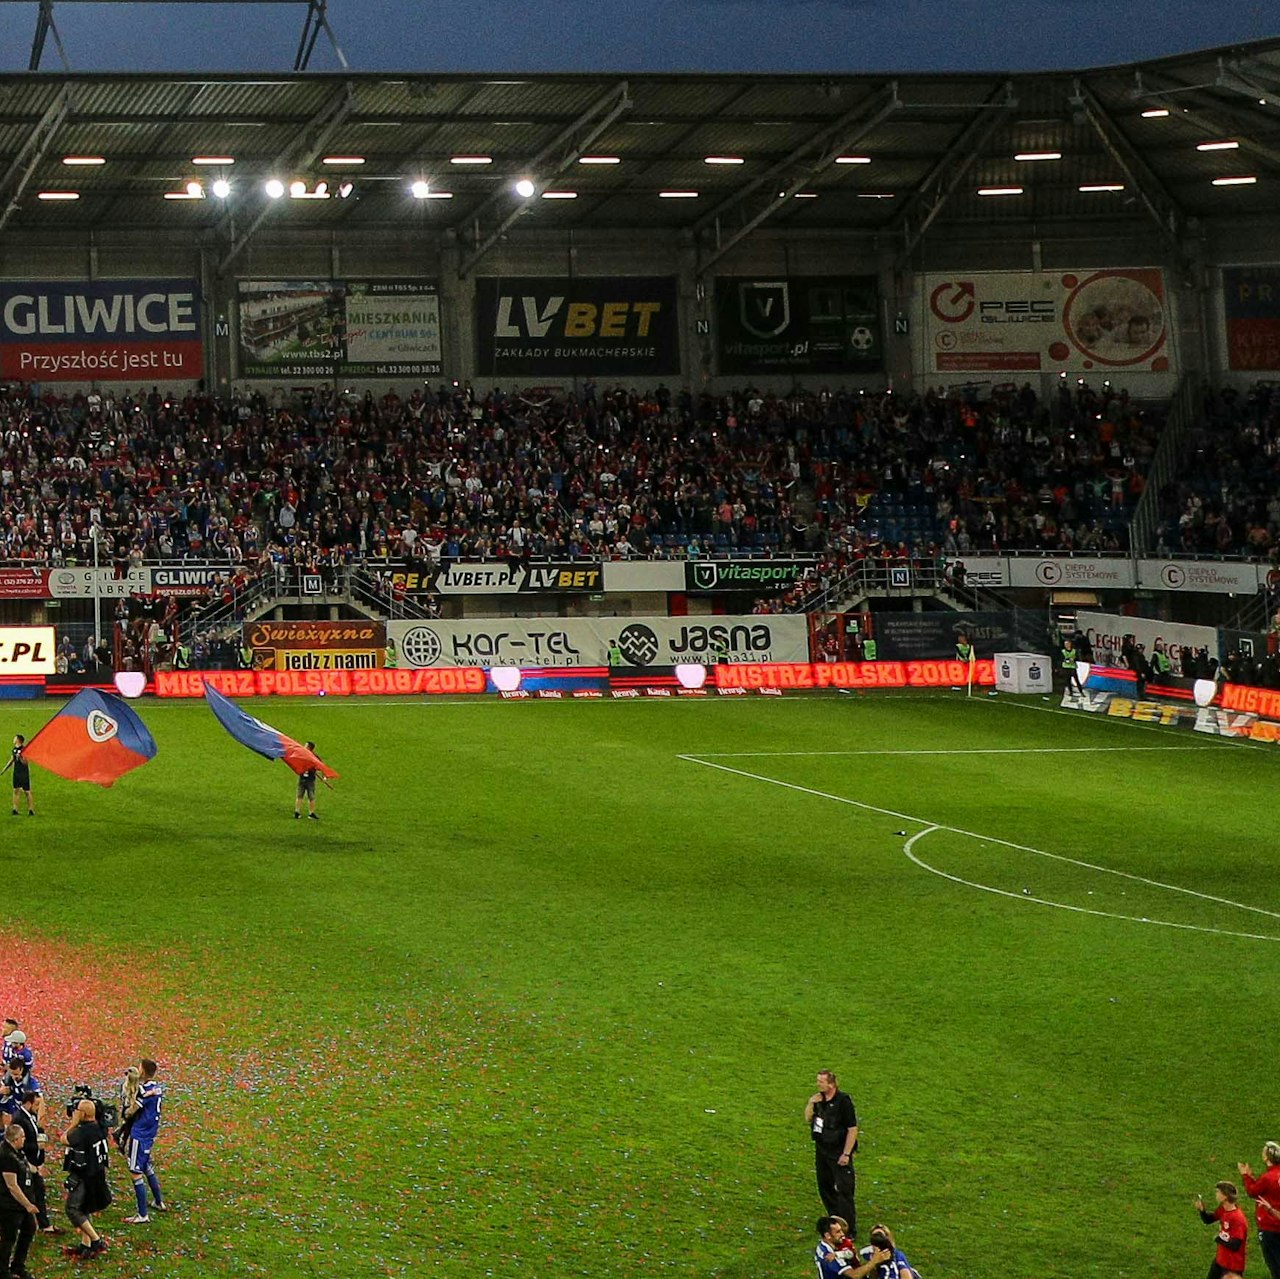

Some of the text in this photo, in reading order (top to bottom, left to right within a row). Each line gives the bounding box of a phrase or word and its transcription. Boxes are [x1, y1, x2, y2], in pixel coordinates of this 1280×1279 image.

[980, 300, 1054, 313] PEC
[3, 293, 196, 334] GLIWICE
[348, 312, 438, 325] MIESZKANIA
[216, 324, 228, 336] M
[697, 321, 708, 334] N
[896, 321, 906, 333] N
[282, 350, 344, 361] www.tbs2.pl
[494, 347, 656, 358] ZAKŁADY BUKMACHERSKIE
[20, 350, 183, 372] Przyszłość jest tu
[1065, 564, 1095, 573] CIEPŁO
[1188, 568, 1218, 577] CIEPŁO
[444, 569, 516, 588] LVBET.PL
[895, 572, 906, 582] N
[1065, 570, 1119, 580] SYSTEMOWE
[1189, 575, 1239, 585] SYSTEMOWE
[308, 579, 318, 589] M
[283, 650, 377, 670] jedz z nami
[453, 655, 581, 666] www.kar-tel.pl
[718, 665, 813, 687] MISTRZ
[816, 663, 906, 686] POLSKI
[158, 669, 483, 694] MISTRZ POLSKI 2018/2019
[501, 689, 530, 699] Henryk
[539, 689, 562, 699] Kania
[611, 688, 640, 699] Henryk
[647, 687, 671, 697] Kania
